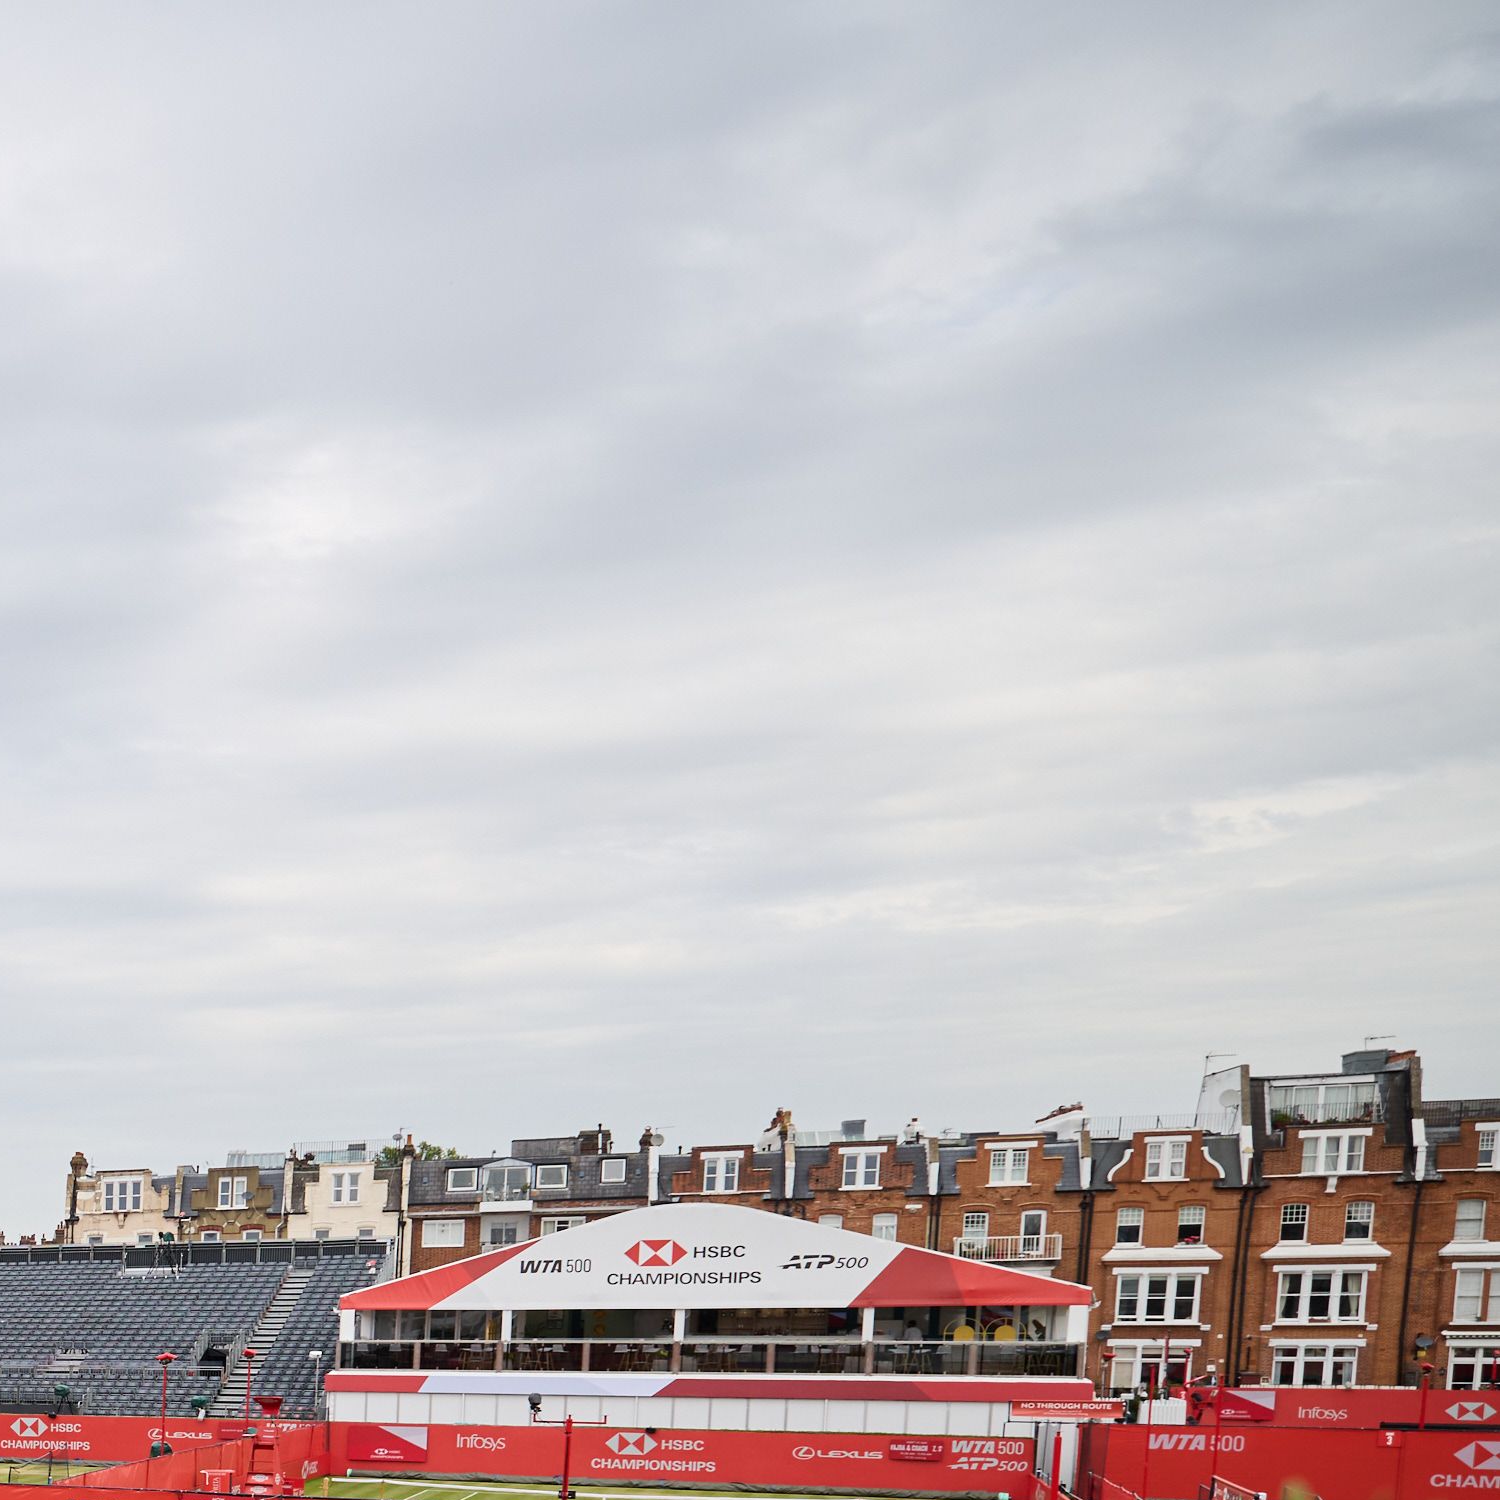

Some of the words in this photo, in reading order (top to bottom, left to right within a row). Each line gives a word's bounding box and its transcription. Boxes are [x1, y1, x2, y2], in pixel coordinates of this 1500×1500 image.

[692, 1245, 746, 1259] HSBC
[519, 1259, 563, 1275] WTA
[566, 1258, 592, 1273] 500
[777, 1254, 835, 1270] ATP
[834, 1256, 869, 1270] 500
[606, 1271, 762, 1286] CHAMPIONSHIPS
[1036, 1402, 1080, 1410] THROUGH
[1081, 1402, 1112, 1410] ROUTE
[1298, 1406, 1348, 1421] Infosys
[50, 1423, 82, 1433] HSBC
[165, 1431, 213, 1440] LEXUS
[0, 1439, 91, 1451] CHAMPIONSHIPS
[456, 1433, 506, 1451] Infosys
[660, 1439, 705, 1452] HSBC
[951, 1440, 995, 1454] WTA
[997, 1441, 1025, 1455] 500
[1148, 1433, 1205, 1451] WTA
[1209, 1435, 1245, 1452] 500
[1386, 1436, 1393, 1446] 3
[817, 1450, 884, 1460] LEXUS
[590, 1458, 717, 1473] CHAMPIONSHIPS
[947, 1457, 999, 1471] ATP
[997, 1460, 1029, 1472] 500
[1430, 1474, 1500, 1489] CHAM
